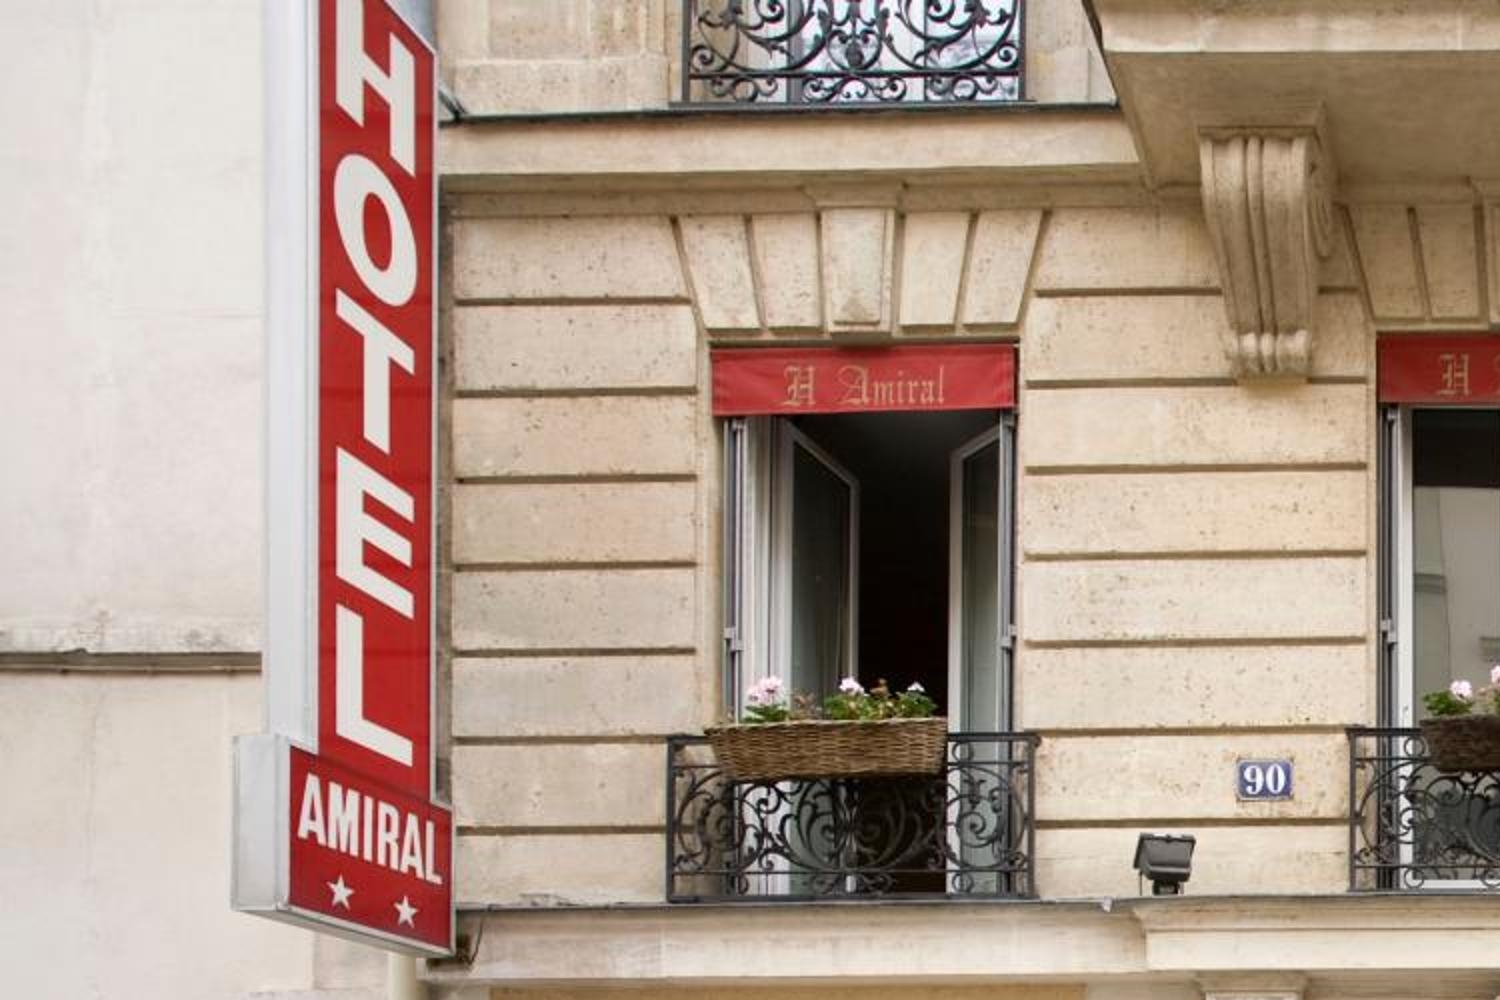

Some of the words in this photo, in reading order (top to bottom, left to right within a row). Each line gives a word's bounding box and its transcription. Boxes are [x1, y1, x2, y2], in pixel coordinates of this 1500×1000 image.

[333, 0, 418, 768] HOTEL
[781, 365, 816, 407] H
[837, 364, 945, 407] Amiral
[1437, 352, 1470, 396] H
[1244, 763, 1285, 795] 90
[297, 772, 443, 885] AMIRAL
